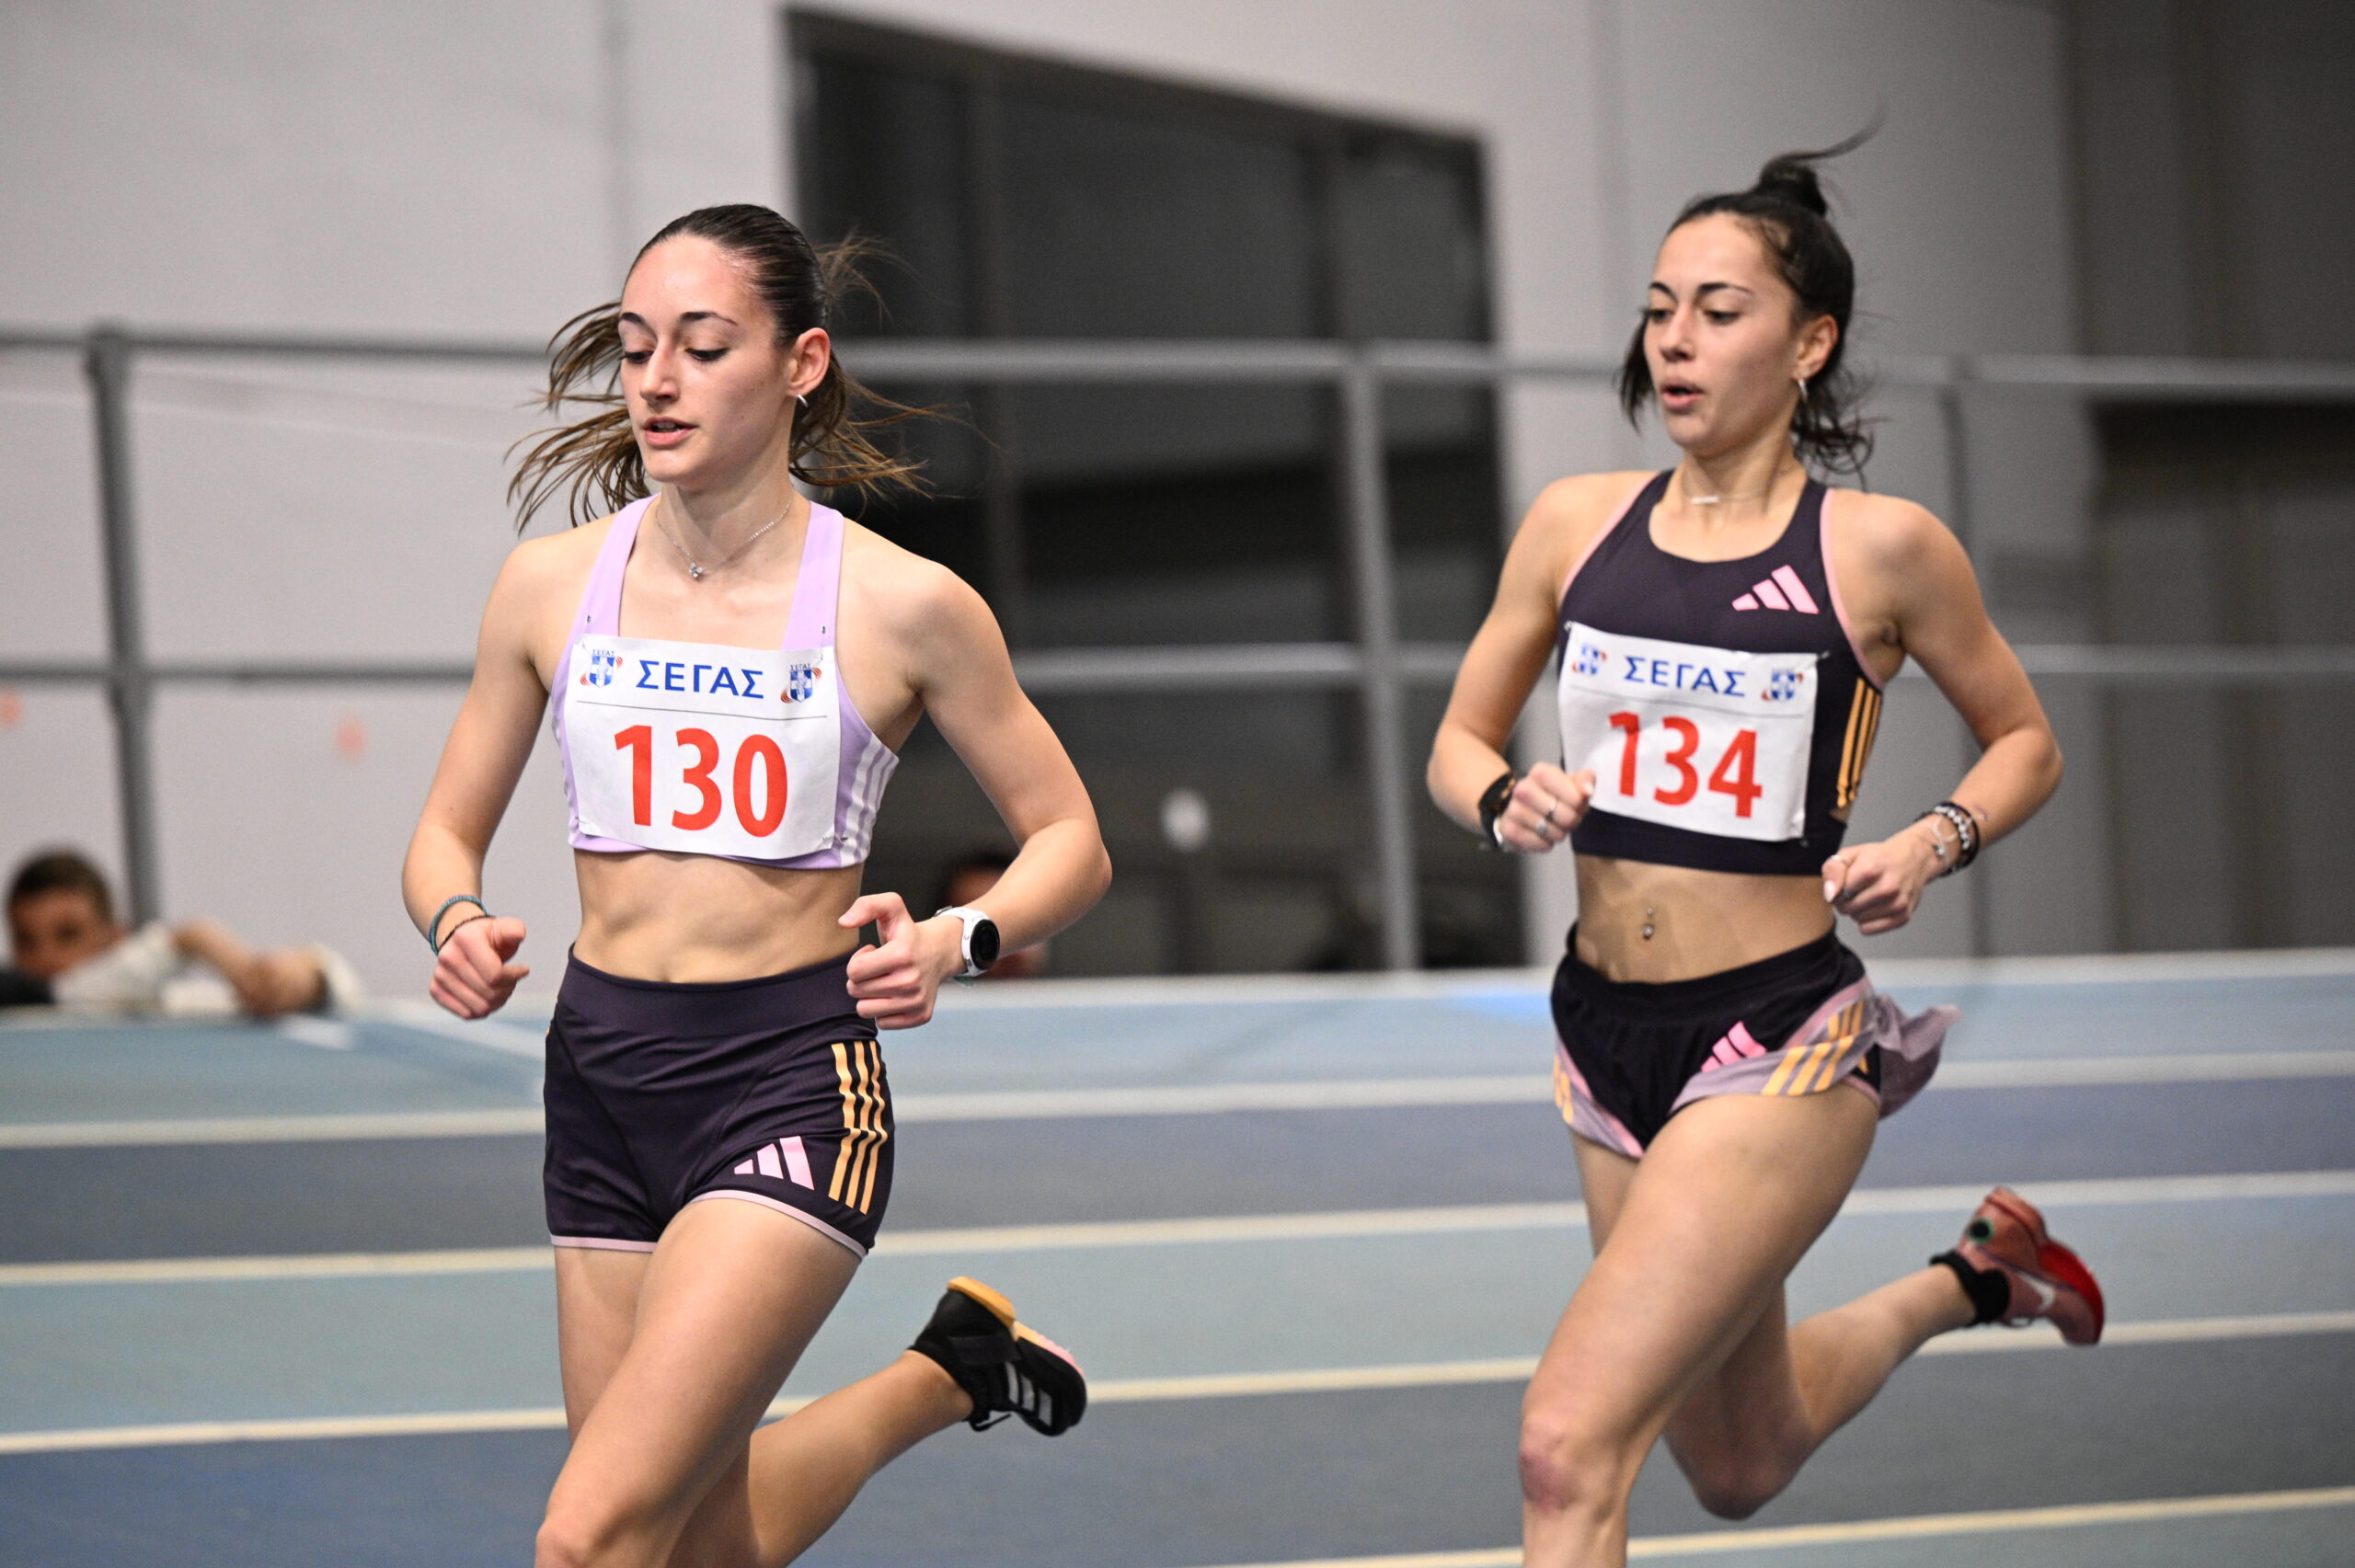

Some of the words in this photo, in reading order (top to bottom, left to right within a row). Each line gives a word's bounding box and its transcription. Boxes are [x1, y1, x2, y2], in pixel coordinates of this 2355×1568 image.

[636, 659, 764, 699] ΣΕΓΑΣ
[1625, 656, 1746, 698] ΣΕΓΑΣ
[614, 725, 787, 838] 130
[1609, 711, 1763, 818] 134
